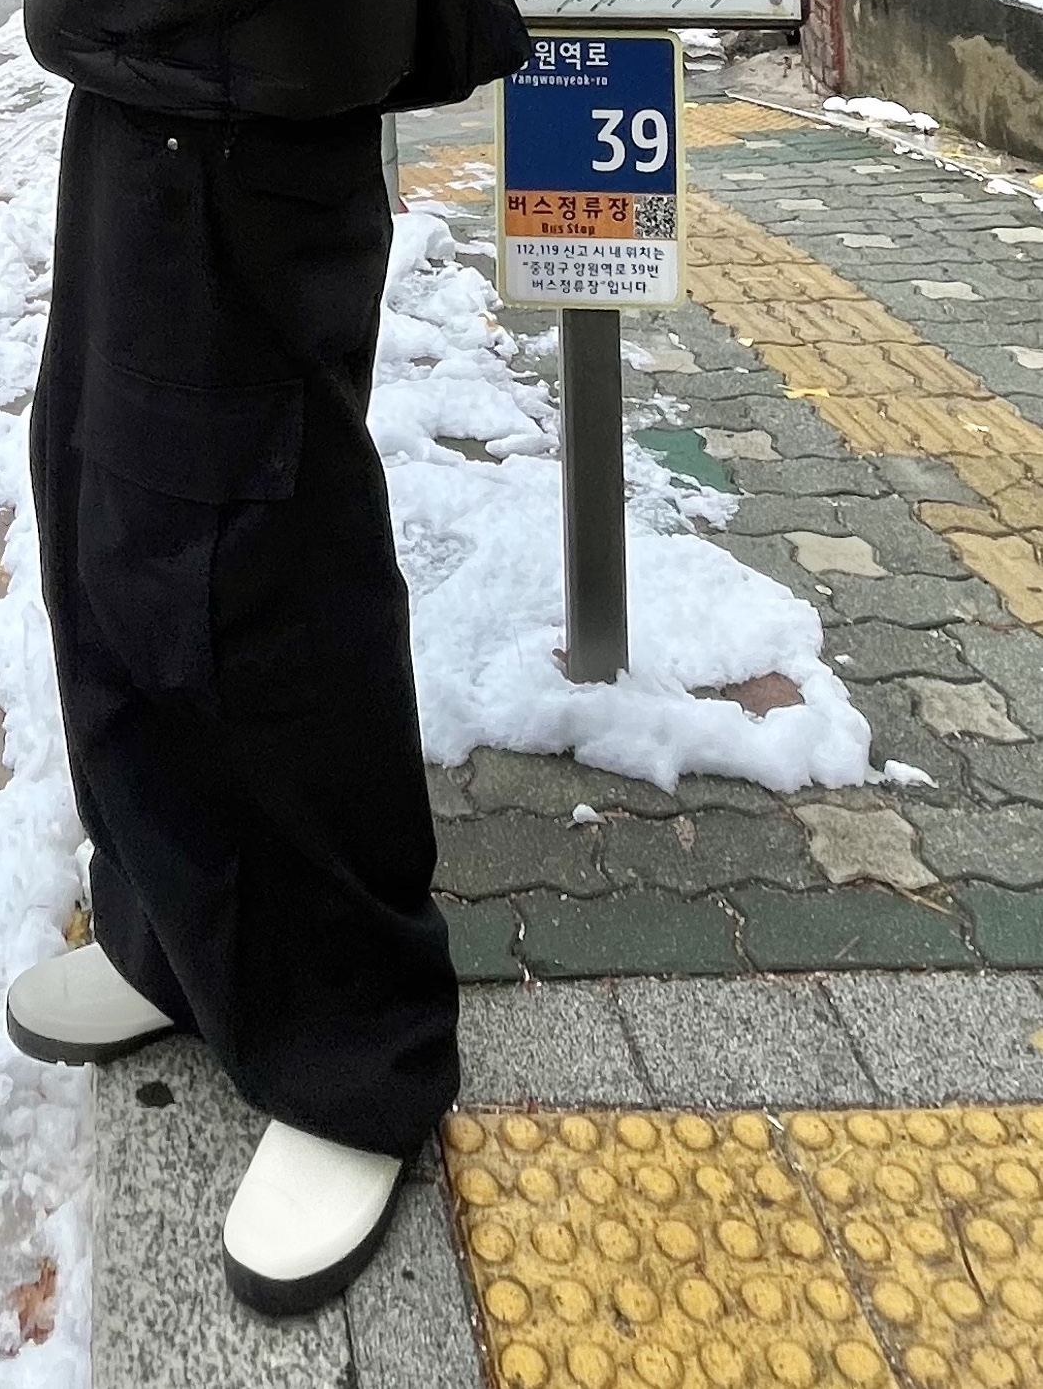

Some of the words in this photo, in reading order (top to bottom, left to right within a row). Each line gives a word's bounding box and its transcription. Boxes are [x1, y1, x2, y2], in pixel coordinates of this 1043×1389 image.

[520, 41, 610, 71] 원역로
[591, 109, 669, 173] 39
[508, 195, 630, 222] 버스정류장
[541, 222, 564, 235] Bus
[566, 223, 596, 236] Stop
[564, 245, 588, 259] 신고
